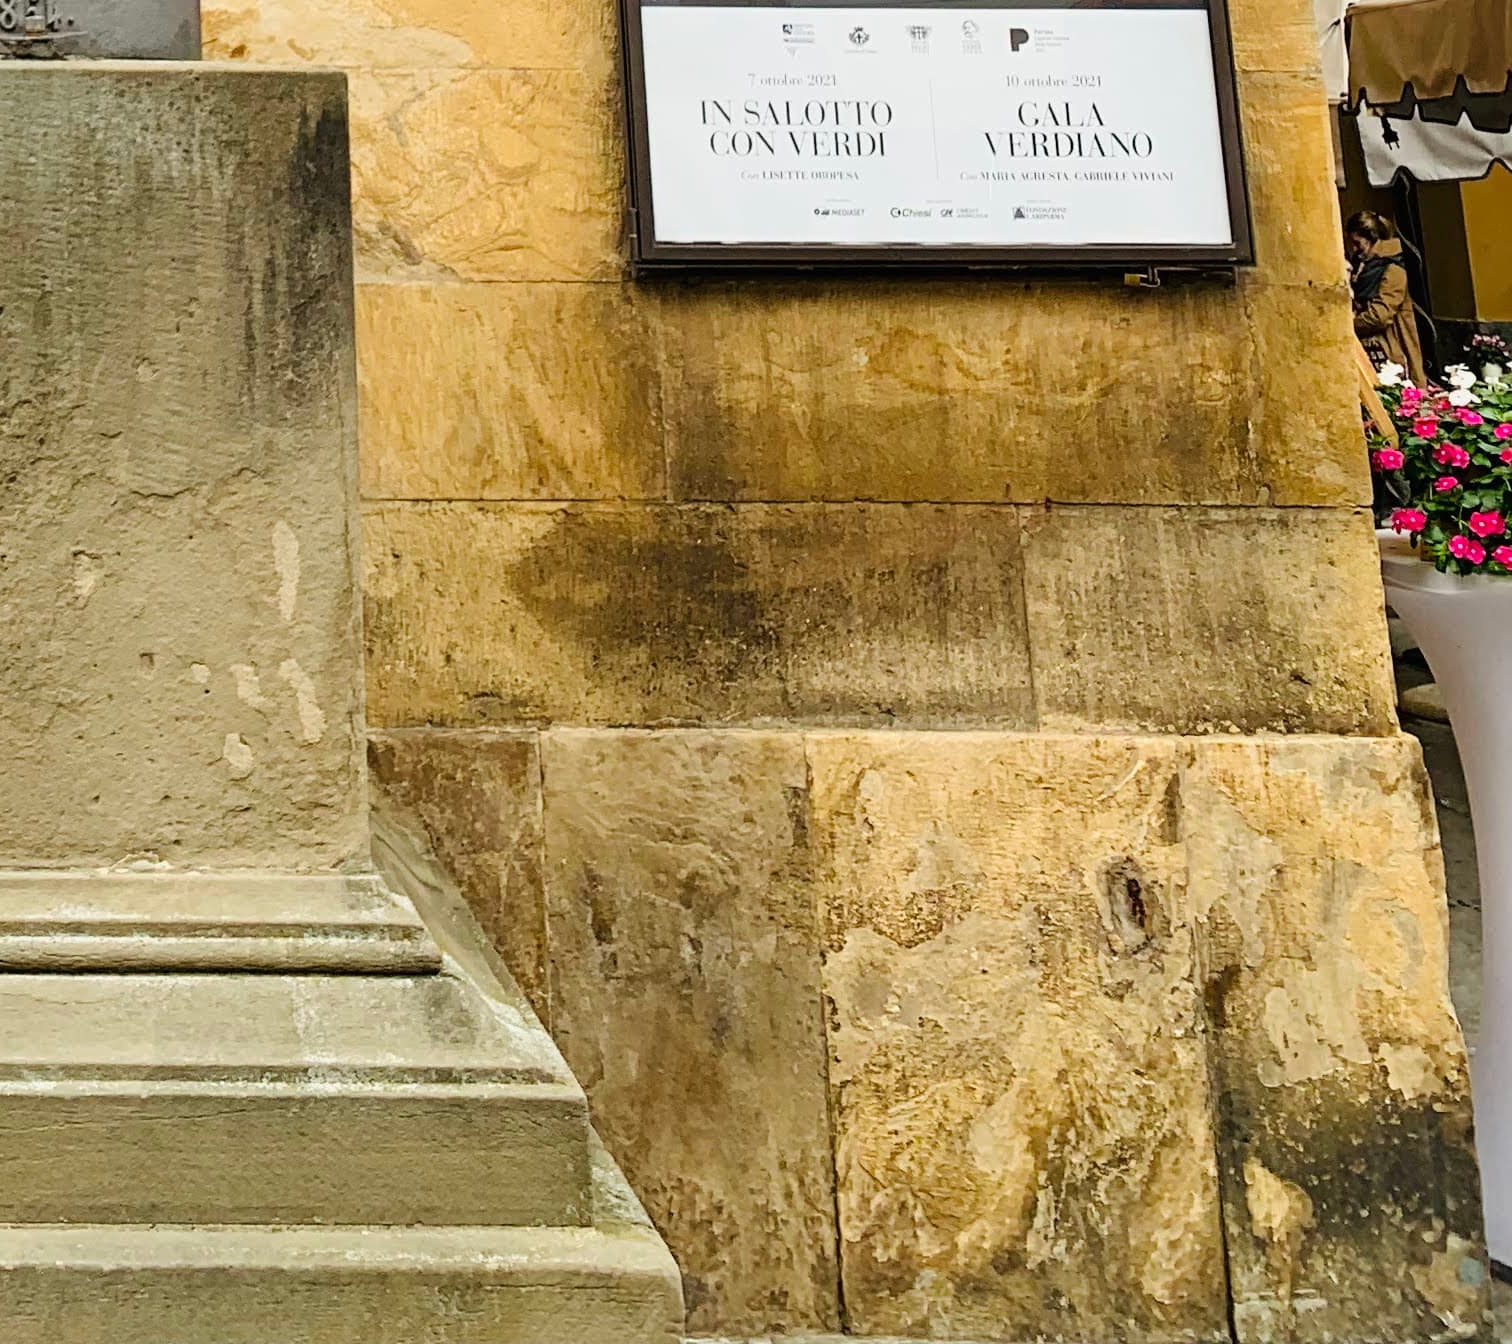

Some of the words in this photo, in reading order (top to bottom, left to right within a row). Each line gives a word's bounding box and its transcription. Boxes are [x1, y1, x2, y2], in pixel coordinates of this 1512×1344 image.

[747, 73, 755, 86] 7
[760, 72, 803, 87] ottobre
[807, 73, 838, 87] 2021
[1004, 75, 1020, 88] 10
[1024, 75, 1068, 88] ottobre
[1071, 75, 1102, 88] 2021
[700, 100, 732, 125] IN
[743, 100, 893, 126] SALOTTO
[1017, 101, 1105, 128] GALA
[709, 130, 776, 157] CON
[787, 131, 888, 157] VERDI
[983, 131, 1153, 158] VERDIANO
